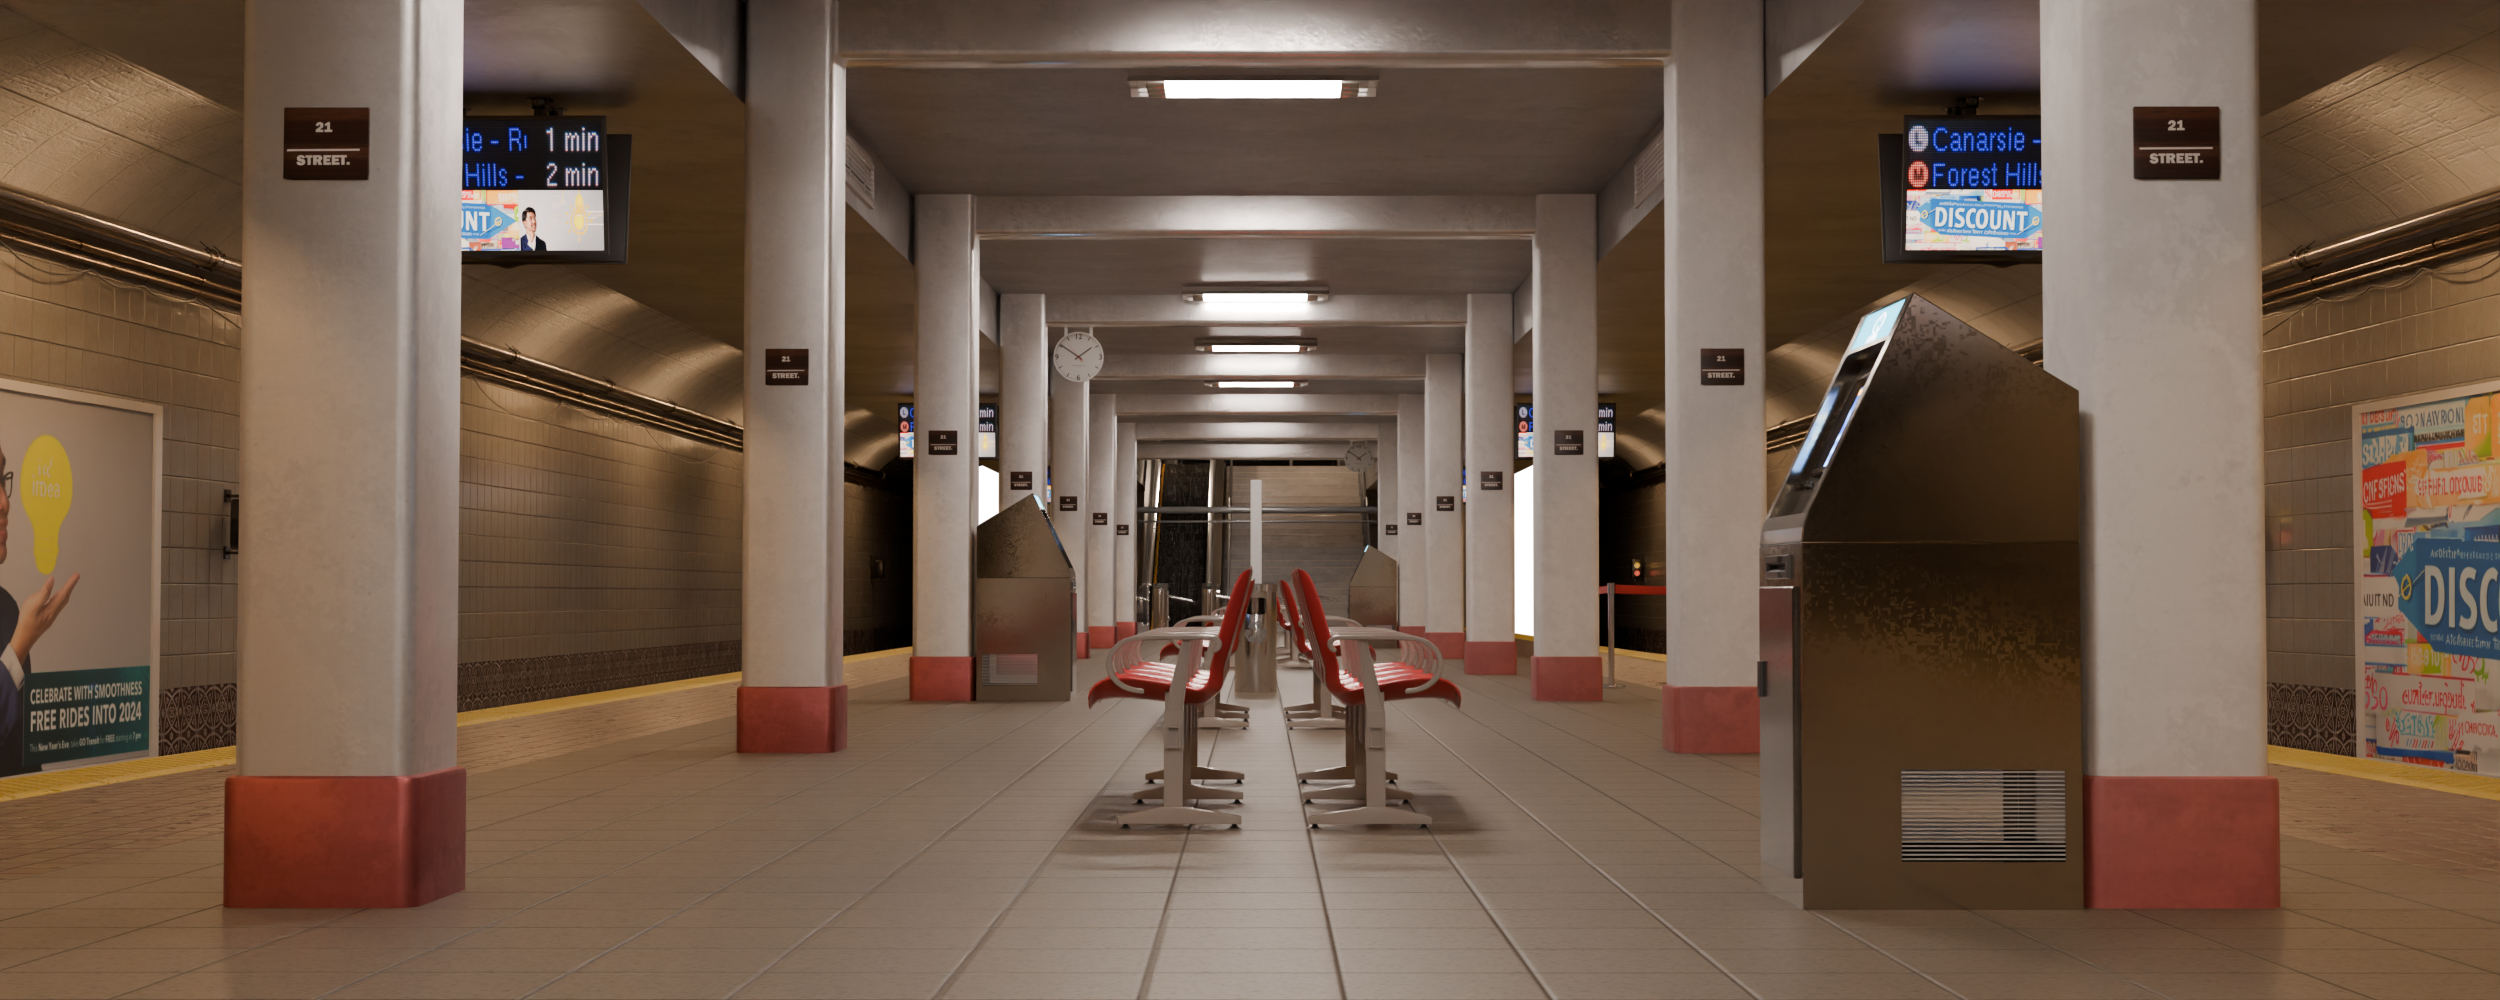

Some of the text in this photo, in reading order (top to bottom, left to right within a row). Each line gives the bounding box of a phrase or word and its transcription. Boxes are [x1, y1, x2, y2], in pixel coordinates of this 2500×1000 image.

[315, 121, 333, 133] 21
[2167, 119, 2185, 131] 21
[463, 127, 483, 152] ie
[545, 126, 599, 152] 1 min
[1932, 126, 2026, 152] Canarsie
[296, 154, 351, 166] STREET.
[2149, 152, 2204, 164] STREET.
[464, 163, 508, 187] Hills
[545, 162, 599, 187] 2 min
[1932, 162, 1998, 188] Forest
[462, 210, 490, 232] NT
[1934, 206, 2029, 232] DISCOUNT
[781, 355, 791, 363] 21
[979, 406, 995, 418] min
[1598, 406, 1614, 418] min
[979, 420, 994, 432] min
[1598, 420, 1613, 432] min
[30, 680, 142, 705] CELEBRATE WITH SMOOTHNESS
[30, 701, 142, 732] FREE RIDES INTO 2024
[38, 743, 49, 752] New
[48, 740, 62, 751] Year's
[105, 733, 116, 743] FREE
